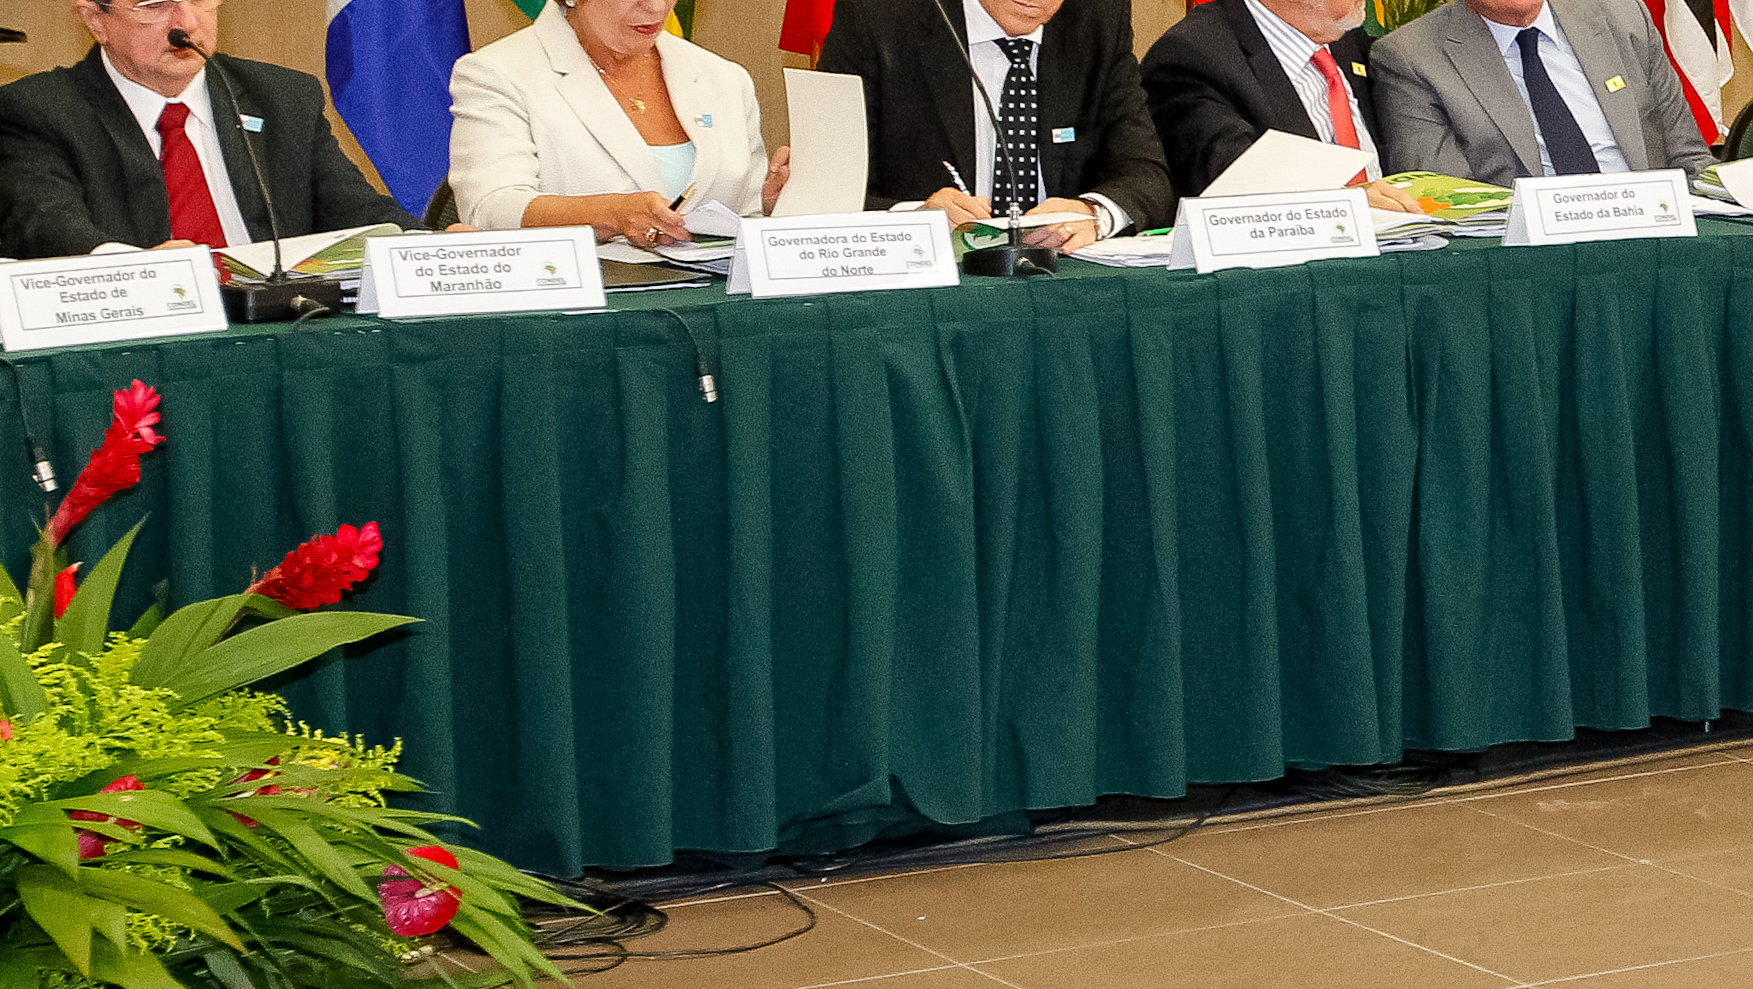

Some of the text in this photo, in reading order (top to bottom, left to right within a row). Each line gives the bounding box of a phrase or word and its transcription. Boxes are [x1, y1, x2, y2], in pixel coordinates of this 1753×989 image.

[1553, 189, 1636, 205] Governador do
[1209, 207, 1347, 226] Governador do Estado
[1554, 206, 1645, 222] Estado da Bahia
[768, 231, 912, 247] Governadora do Estado
[1250, 224, 1316, 239] da Paraíba
[398, 245, 522, 262] Vice-Governador
[799, 246, 887, 260] do Rio Grande
[415, 262, 512, 277] do Estado do
[822, 264, 875, 277] do Norte
[20, 268, 157, 291] Vice-Governador do
[430, 278, 502, 293] Maranhão
[59, 287, 128, 303] Estado de
[56, 306, 144, 324] Minas Gerais
